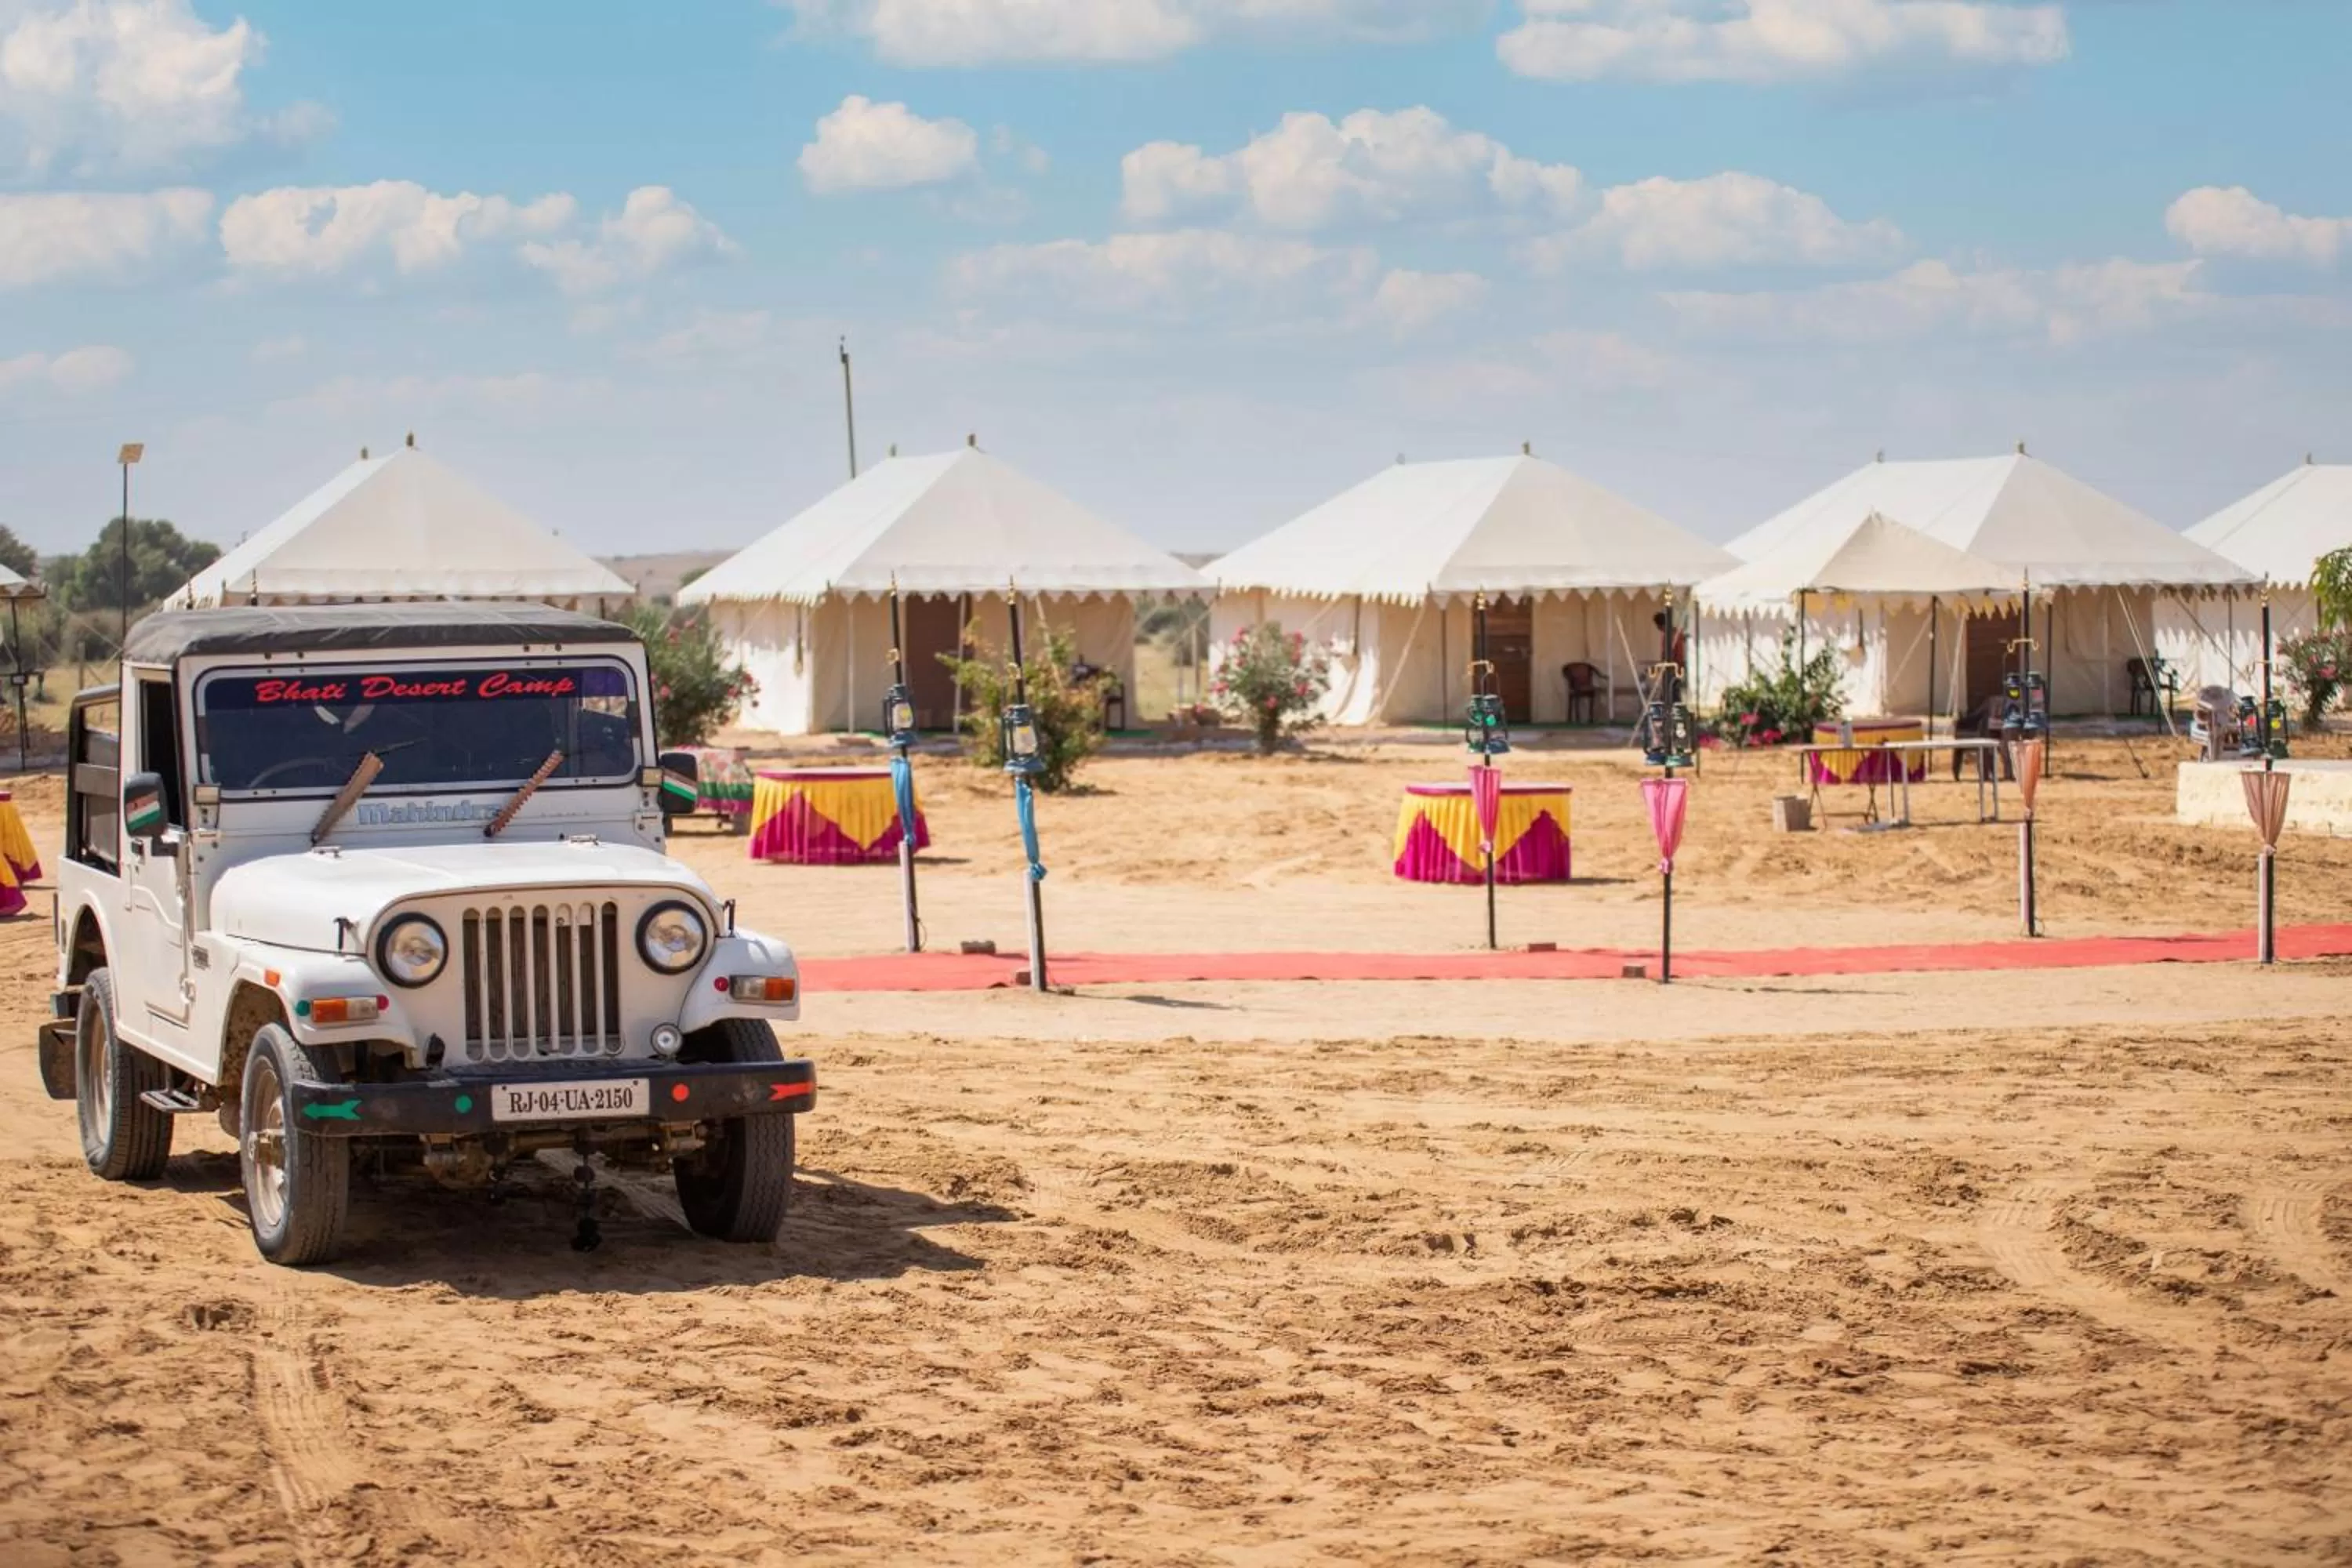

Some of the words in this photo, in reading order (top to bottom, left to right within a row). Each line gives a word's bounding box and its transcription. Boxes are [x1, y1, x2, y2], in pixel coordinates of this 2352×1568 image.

[255, 680, 347, 702] Bhati
[361, 676, 468, 697] Desert
[478, 673, 576, 696] Camp
